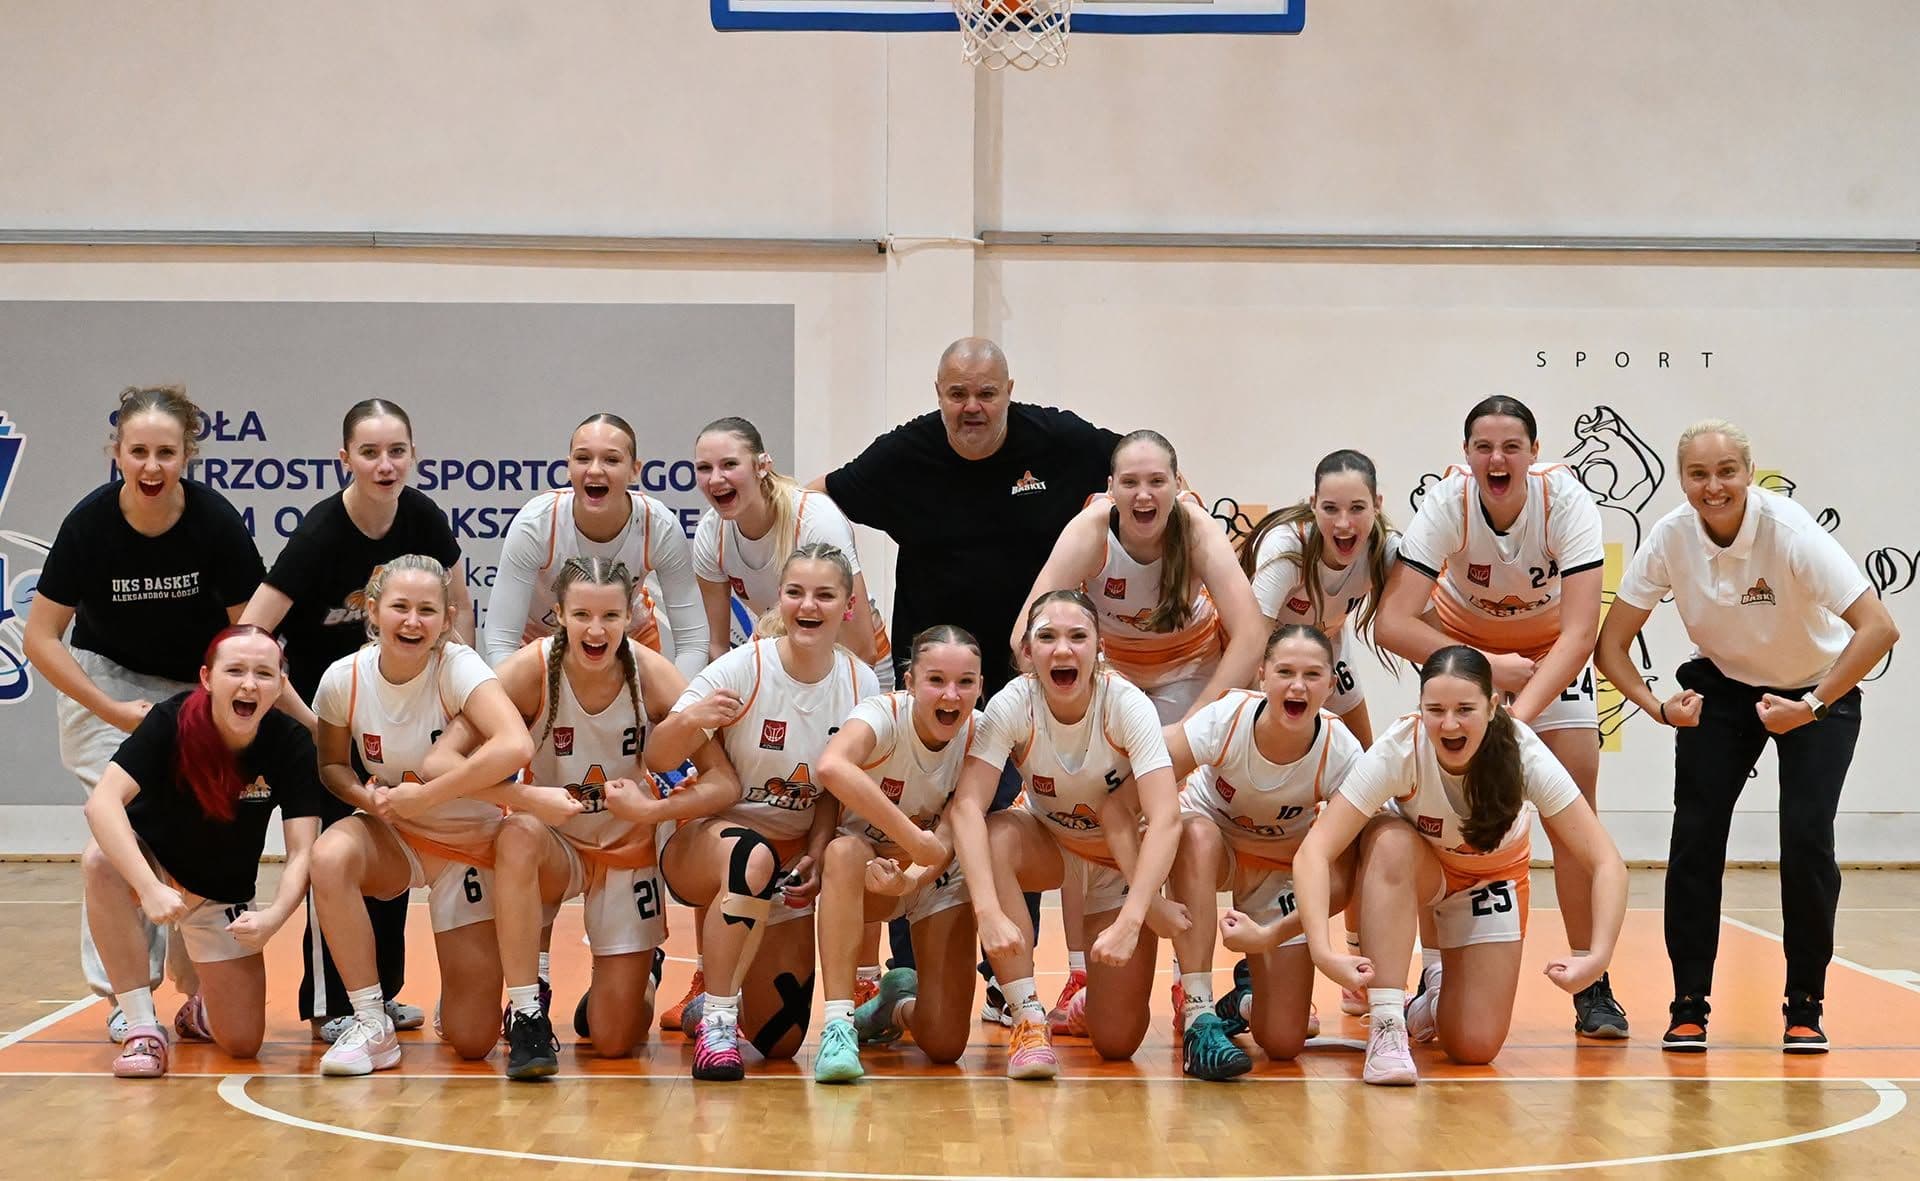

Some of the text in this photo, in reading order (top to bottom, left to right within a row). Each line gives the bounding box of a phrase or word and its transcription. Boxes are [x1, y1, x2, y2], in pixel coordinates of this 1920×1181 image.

[1536, 351, 1714, 369] SPORT
[417, 459, 697, 492] SPORTOGO
[112, 572, 200, 592] UKS BASKET
[1529, 560, 1559, 589] 24
[1276, 805, 1304, 820] 10
[464, 867, 482, 903] 6
[634, 878, 660, 920] 21
[1470, 880, 1512, 917] 25
